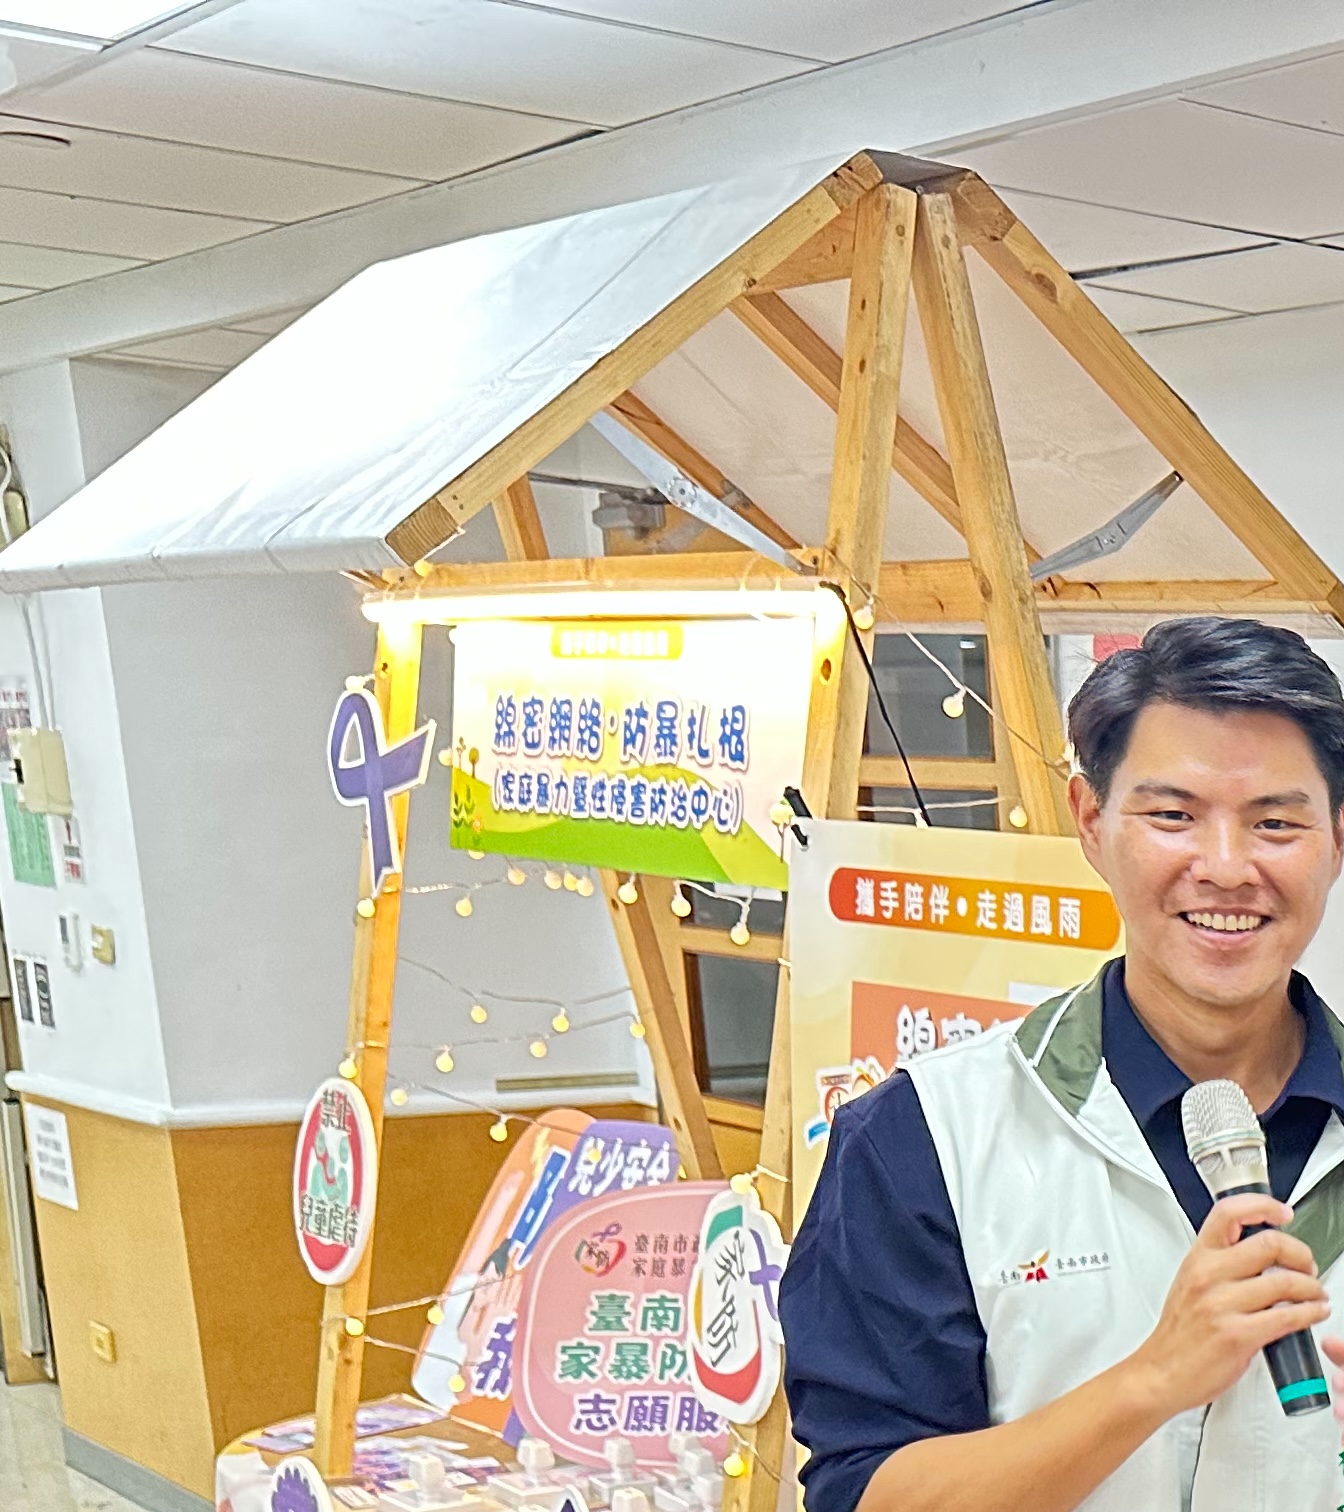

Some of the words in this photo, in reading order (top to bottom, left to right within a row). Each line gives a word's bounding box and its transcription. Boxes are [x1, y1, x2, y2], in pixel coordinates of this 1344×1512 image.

[322, 1089, 352, 1134] 禁止
[634, 1233, 699, 1255] 臺南市
[588, 1293, 682, 1333] 臺南
